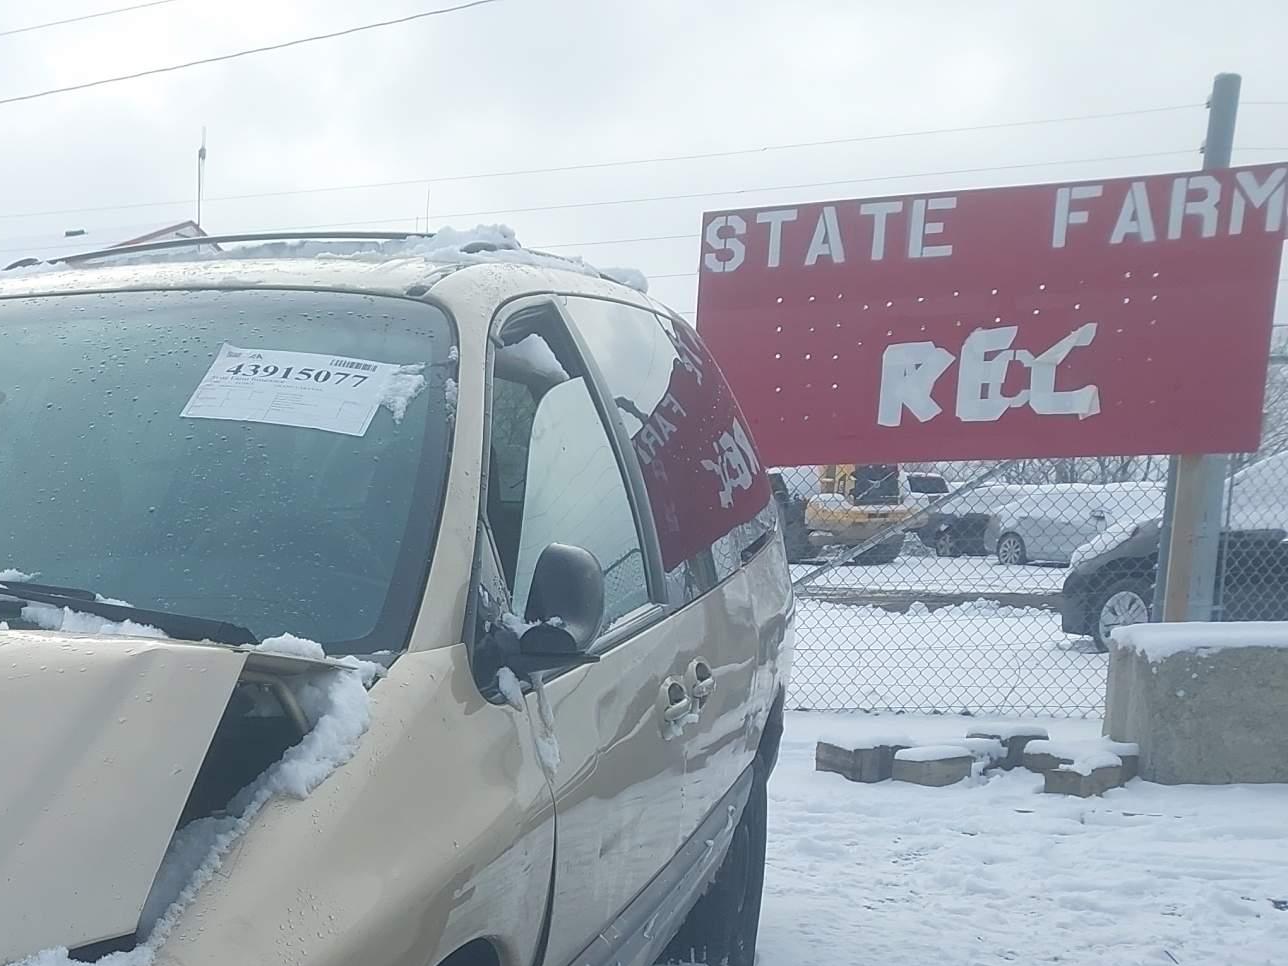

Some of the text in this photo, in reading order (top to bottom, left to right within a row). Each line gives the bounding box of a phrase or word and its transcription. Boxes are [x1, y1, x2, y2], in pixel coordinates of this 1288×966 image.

[705, 167, 1288, 273] STATE FARM
[225, 362, 369, 388] 43915077
[877, 322, 1101, 427] REC
